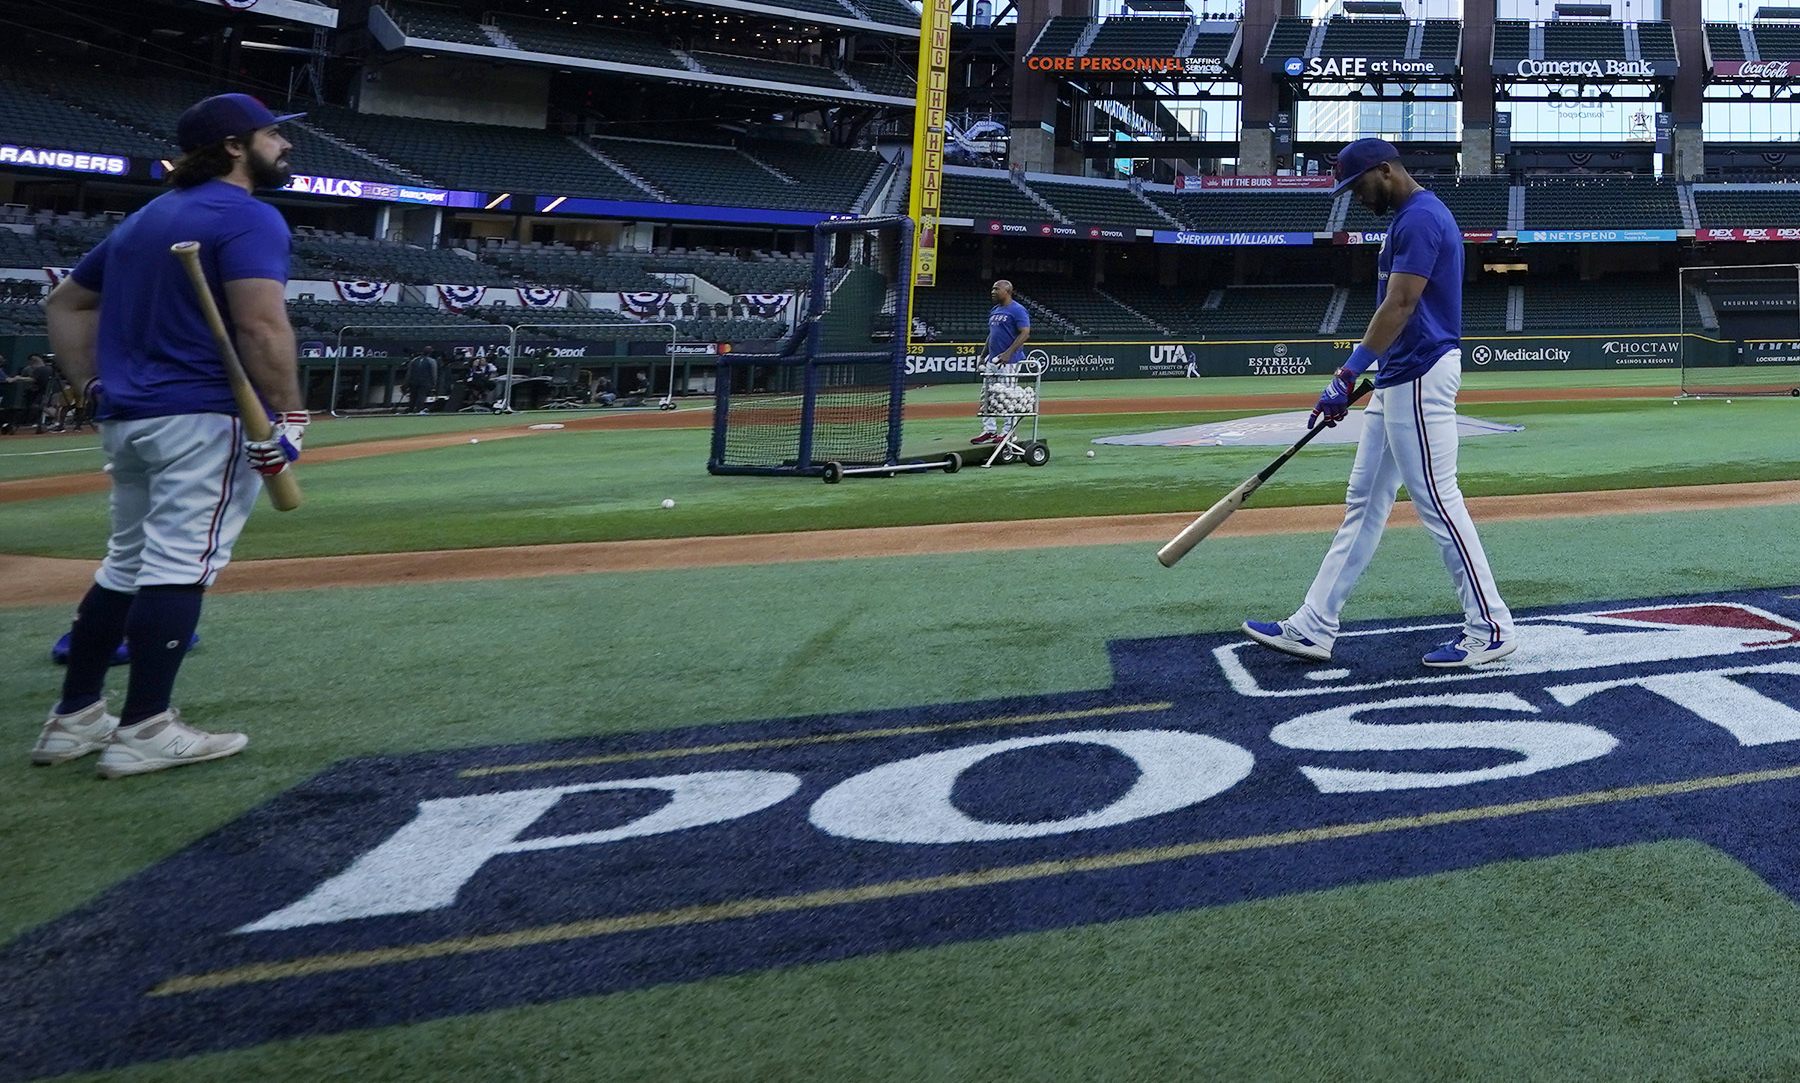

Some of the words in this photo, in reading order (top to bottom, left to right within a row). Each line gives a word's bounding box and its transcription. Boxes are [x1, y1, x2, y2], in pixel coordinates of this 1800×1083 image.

[1028, 56, 1074, 70] CORE
[1080, 57, 1184, 71] PERSONNEL
[1287, 62, 1302, 71] ADT
[1309, 57, 1367, 77] SAFE
[1371, 59, 1388, 72] at
[1392, 59, 1434, 72] home
[1605, 59, 1655, 76] Bank
[931, 71, 942, 128] THE
[0, 145, 125, 173] RANGERS
[924, 131, 939, 209] HEAT
[313, 177, 362, 198] ALCS
[363, 184, 399, 199] 2023
[1221, 177, 1234, 188] HIT
[1235, 177, 1250, 188] THE
[1251, 177, 1272, 188] BUDS
[1002, 224, 1028, 233] TOYOTA
[1053, 226, 1077, 235] TOYOTA
[1101, 229, 1123, 238] TOYOTA
[1709, 229, 1733, 237] DEX
[1743, 229, 1767, 237] DEX
[1777, 229, 1800, 237] DEX
[1549, 231, 1617, 241] NETSPEND
[957, 345, 975, 354] 334
[1333, 341, 1351, 349] 372
[1610, 341, 1679, 353] CHOCTAW
[325, 346, 365, 358] MLB
[1150, 345, 1187, 363] UTA
[1494, 348, 1543, 361] Medical
[1544, 349, 1571, 364] City
[1248, 356, 1312, 367] ESTRELLA
[1253, 365, 1306, 376] JALISCO
